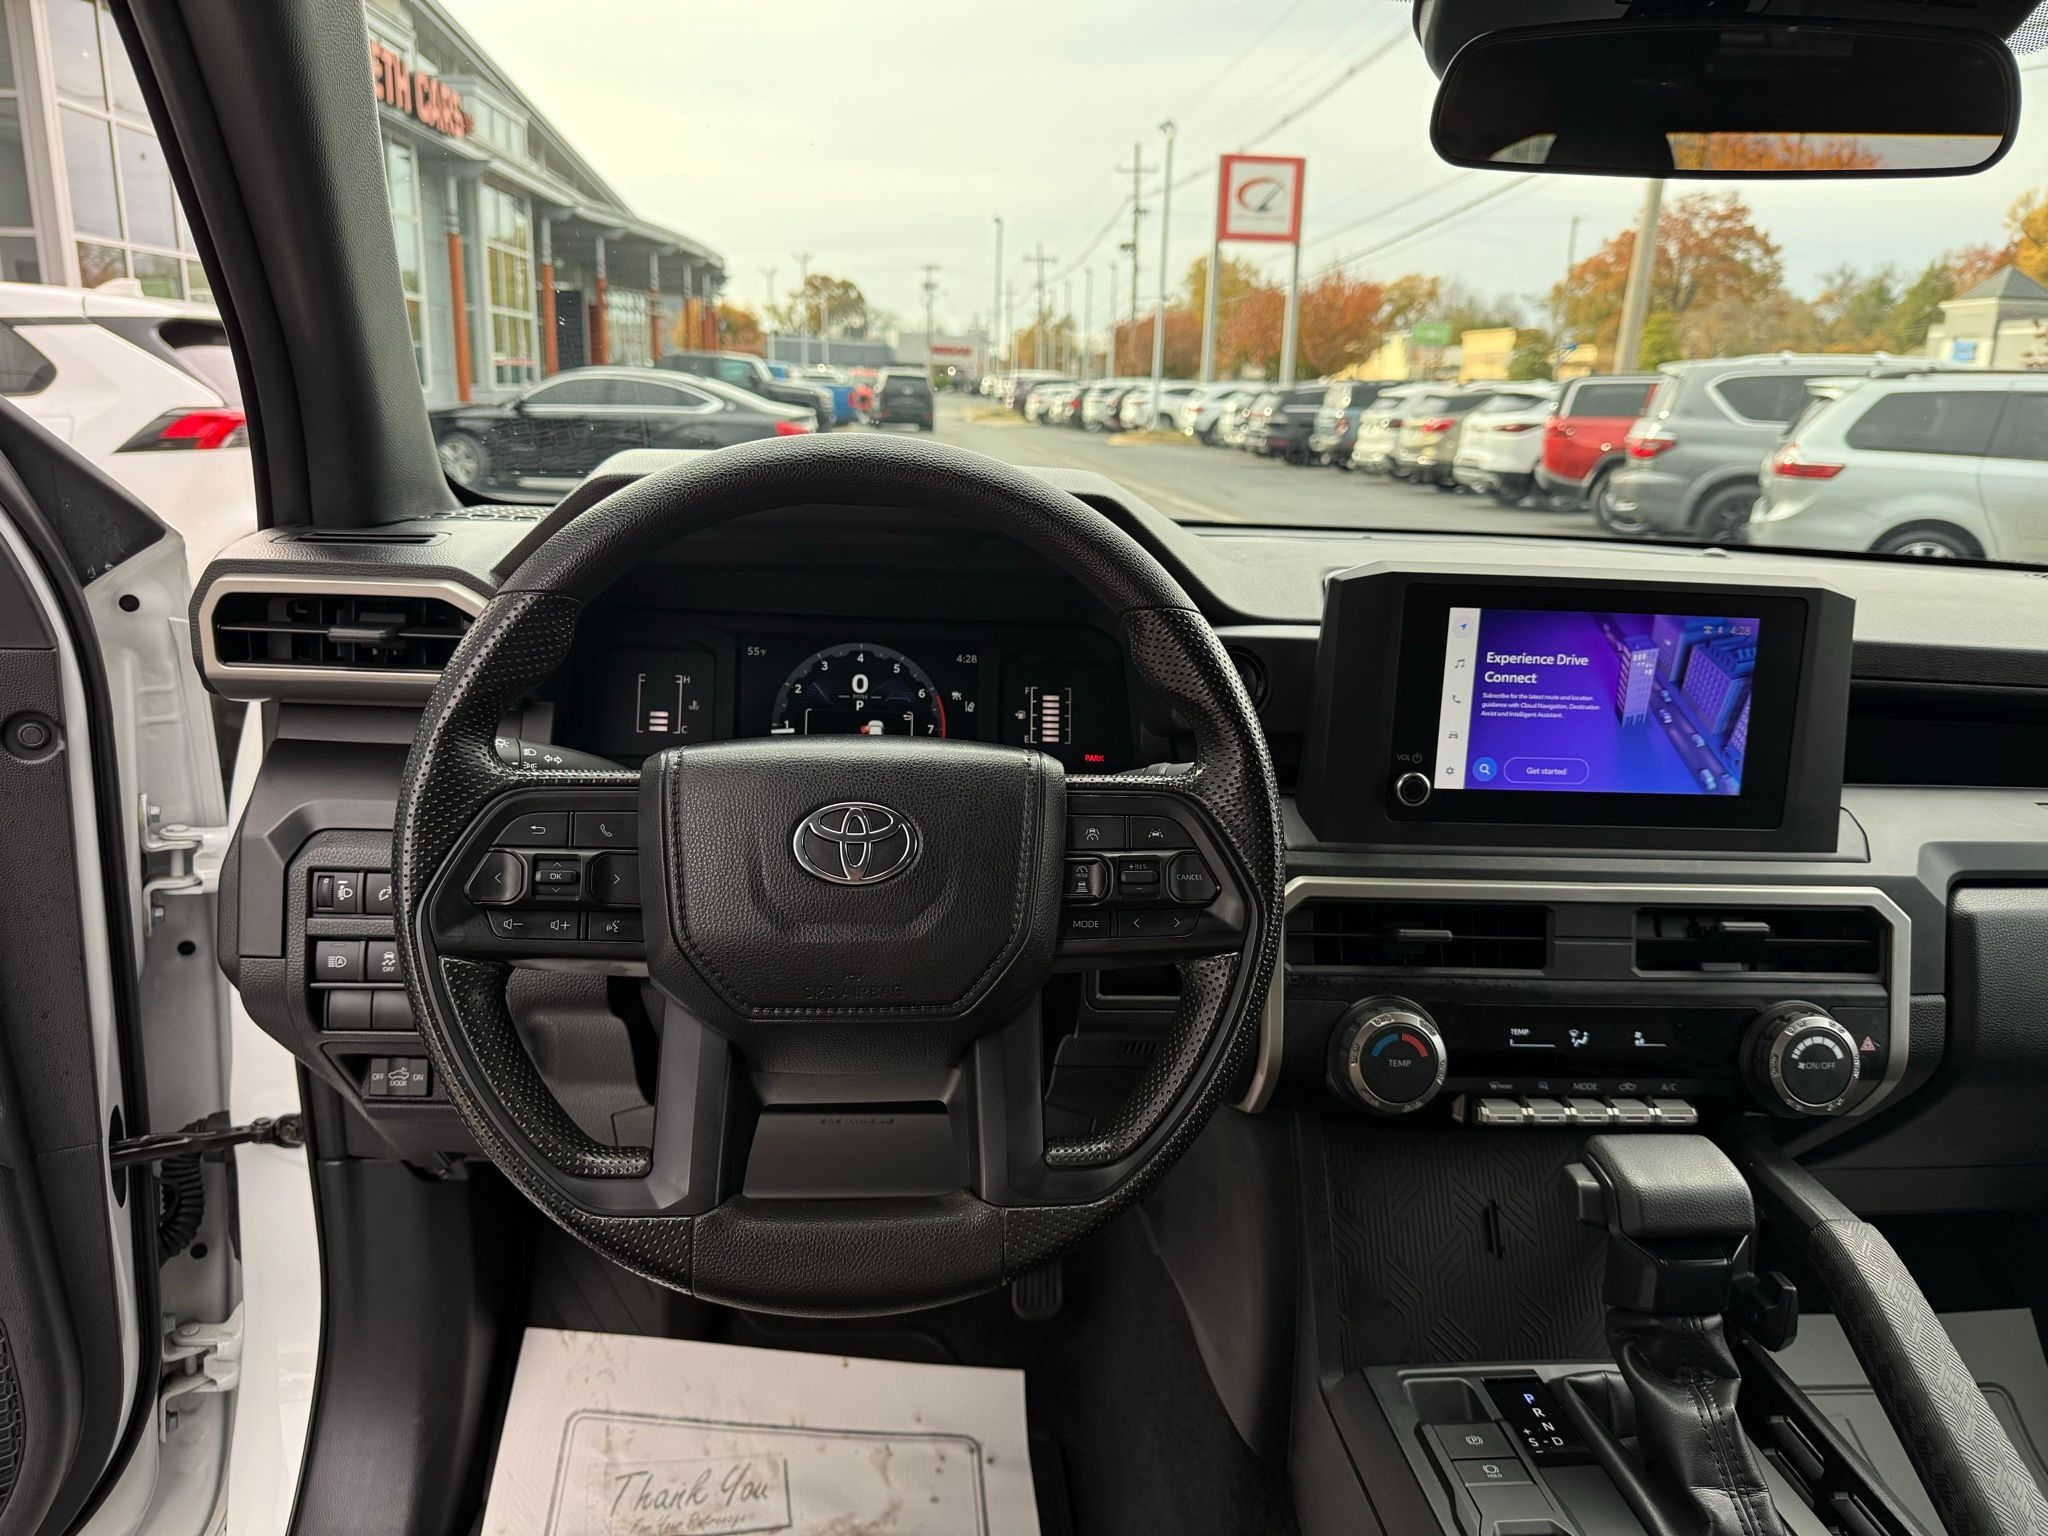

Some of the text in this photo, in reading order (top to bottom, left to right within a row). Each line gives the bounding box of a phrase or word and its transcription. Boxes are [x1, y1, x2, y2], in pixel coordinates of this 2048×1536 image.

[1729, 626, 1751, 636] 4:28
[857, 654, 864, 663] 4
[956, 655, 977, 664] 4:28
[1486, 652, 1589, 666] Experience Drive
[821, 661, 829, 671] 3
[893, 664, 901, 673] 5
[683, 675, 691, 684] H
[1484, 671, 1538, 684] Connect
[851, 674, 869, 694] 0
[795, 684, 802, 694] 2
[918, 688, 926, 698] 6
[856, 701, 865, 712] P
[681, 725, 688, 734] C
[927, 725, 934, 734] 7
[1084, 754, 1105, 762] PARK
[1526, 767, 1540, 775] Get
[1073, 920, 1100, 928] MODE
[1510, 1028, 1530, 1036] TEMP
[1388, 1059, 1412, 1068] TEMP
[372, 1073, 385, 1081] OFF
[1573, 1083, 1598, 1091] MODE
[1661, 1083, 1677, 1091] A/C
[1523, 1393, 1535, 1404] P
[1532, 1407, 1545, 1418] R
[1541, 1421, 1555, 1432] N
[1551, 1436, 1564, 1446] D
[611, 1462, 769, 1517] Thank You
